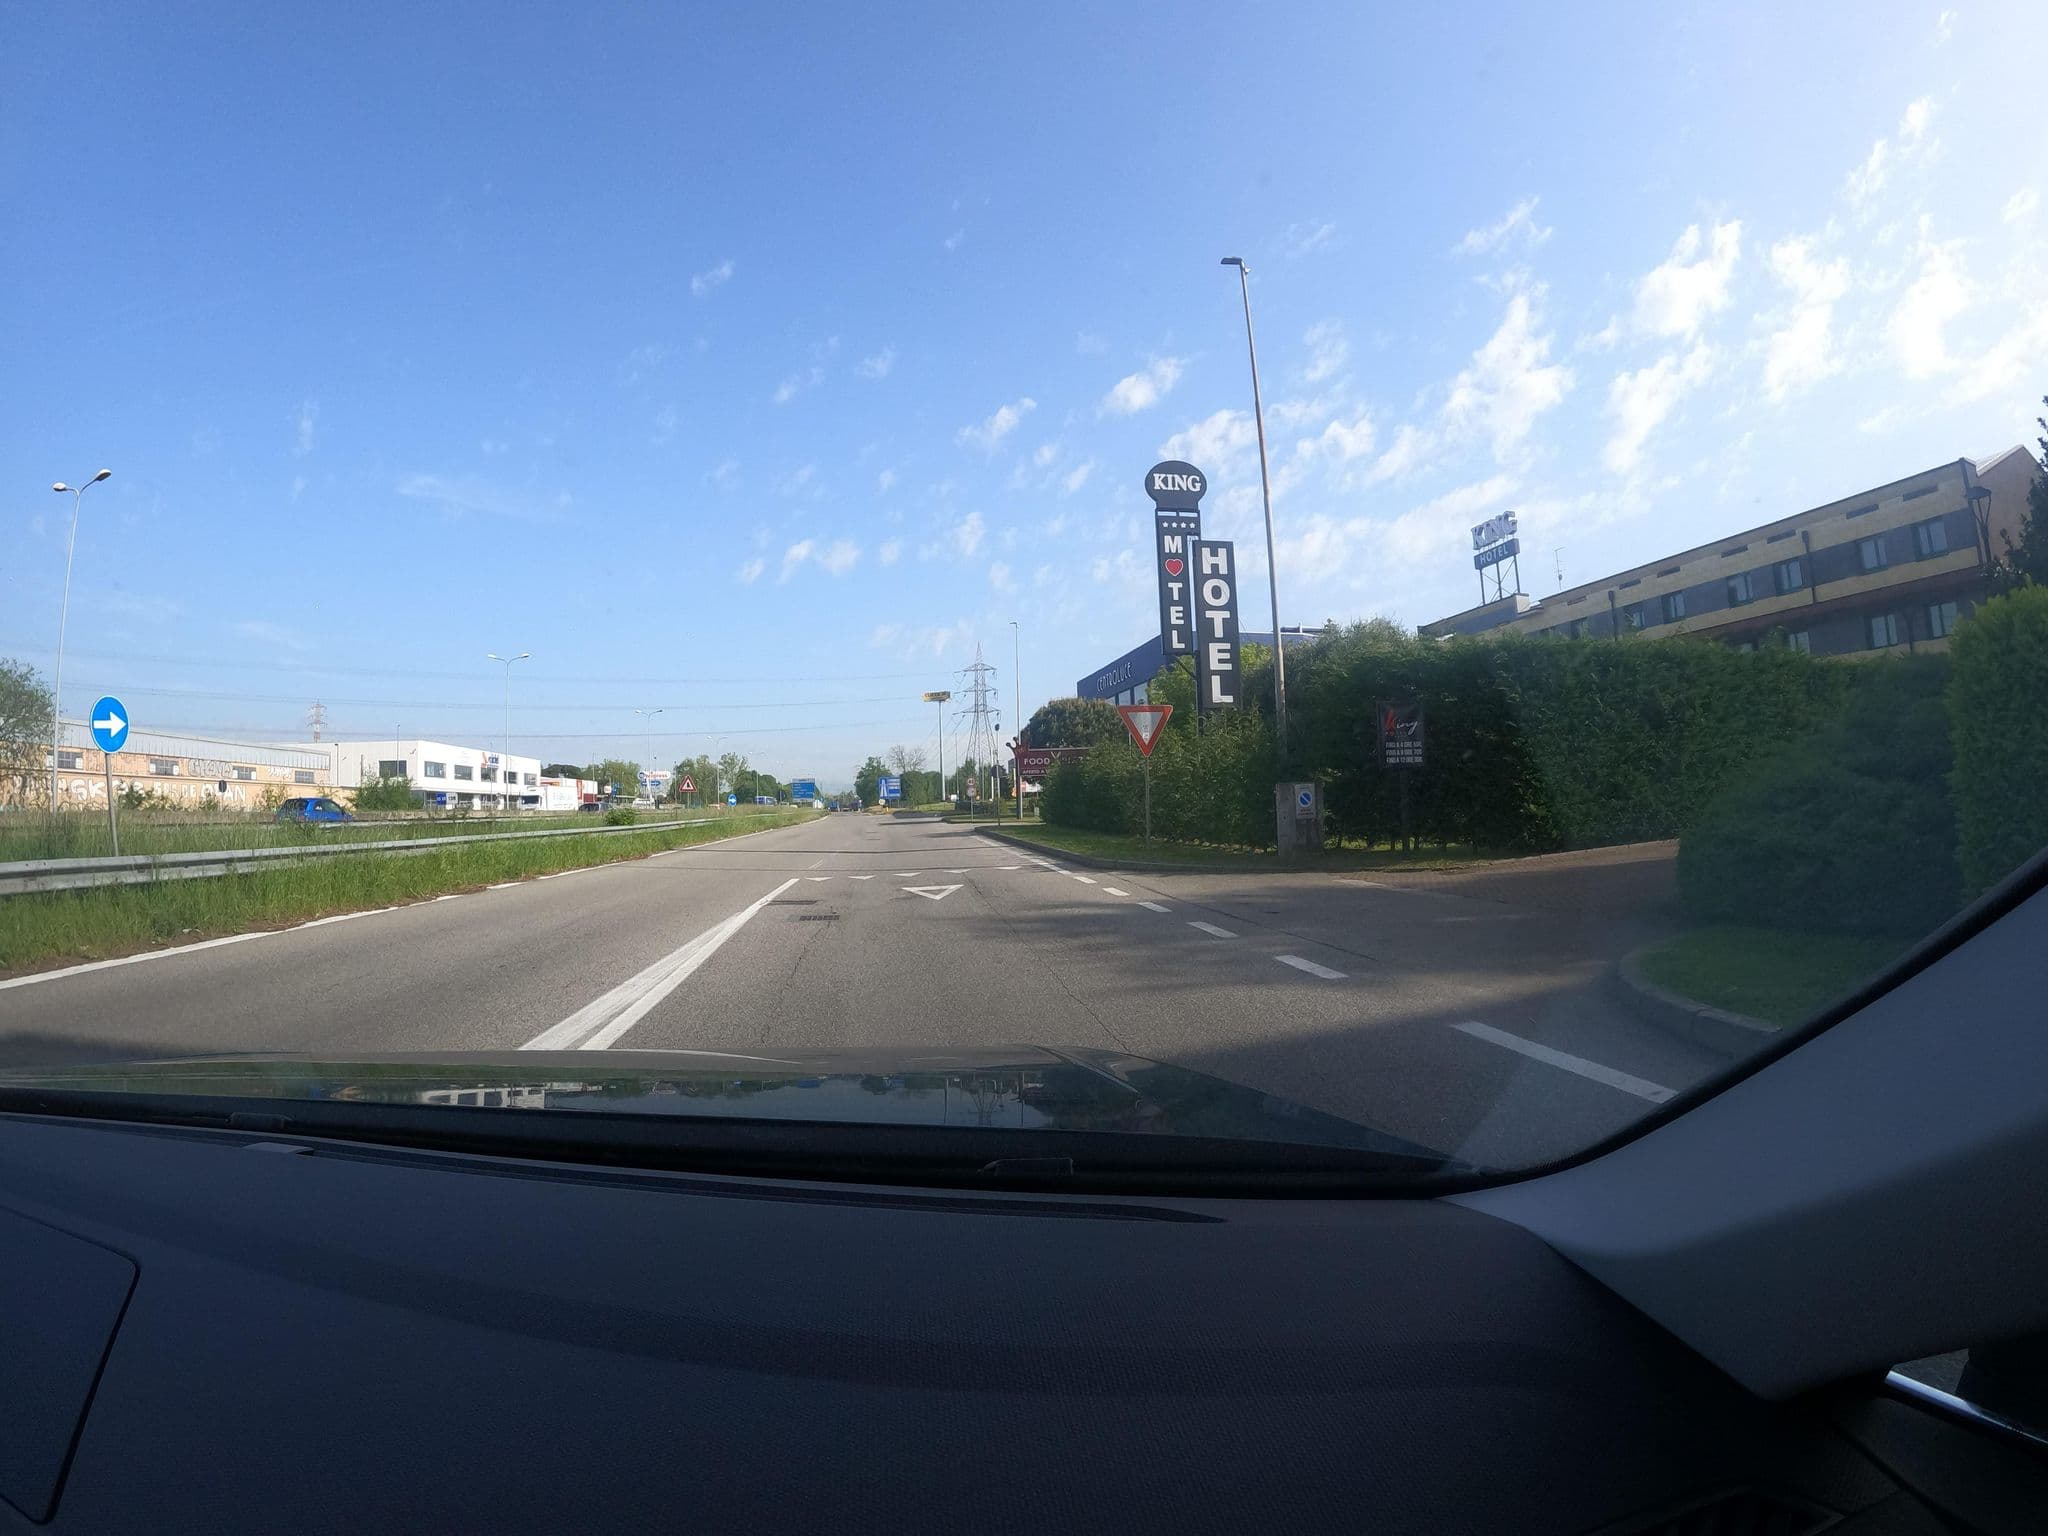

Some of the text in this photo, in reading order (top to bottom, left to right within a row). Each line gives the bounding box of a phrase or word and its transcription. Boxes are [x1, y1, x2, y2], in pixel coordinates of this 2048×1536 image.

[1153, 473, 1202, 493] KING
[1471, 511, 1517, 550] KING
[1480, 545, 1509, 565] HOTEL
[1201, 546, 1234, 704] HOTEL
